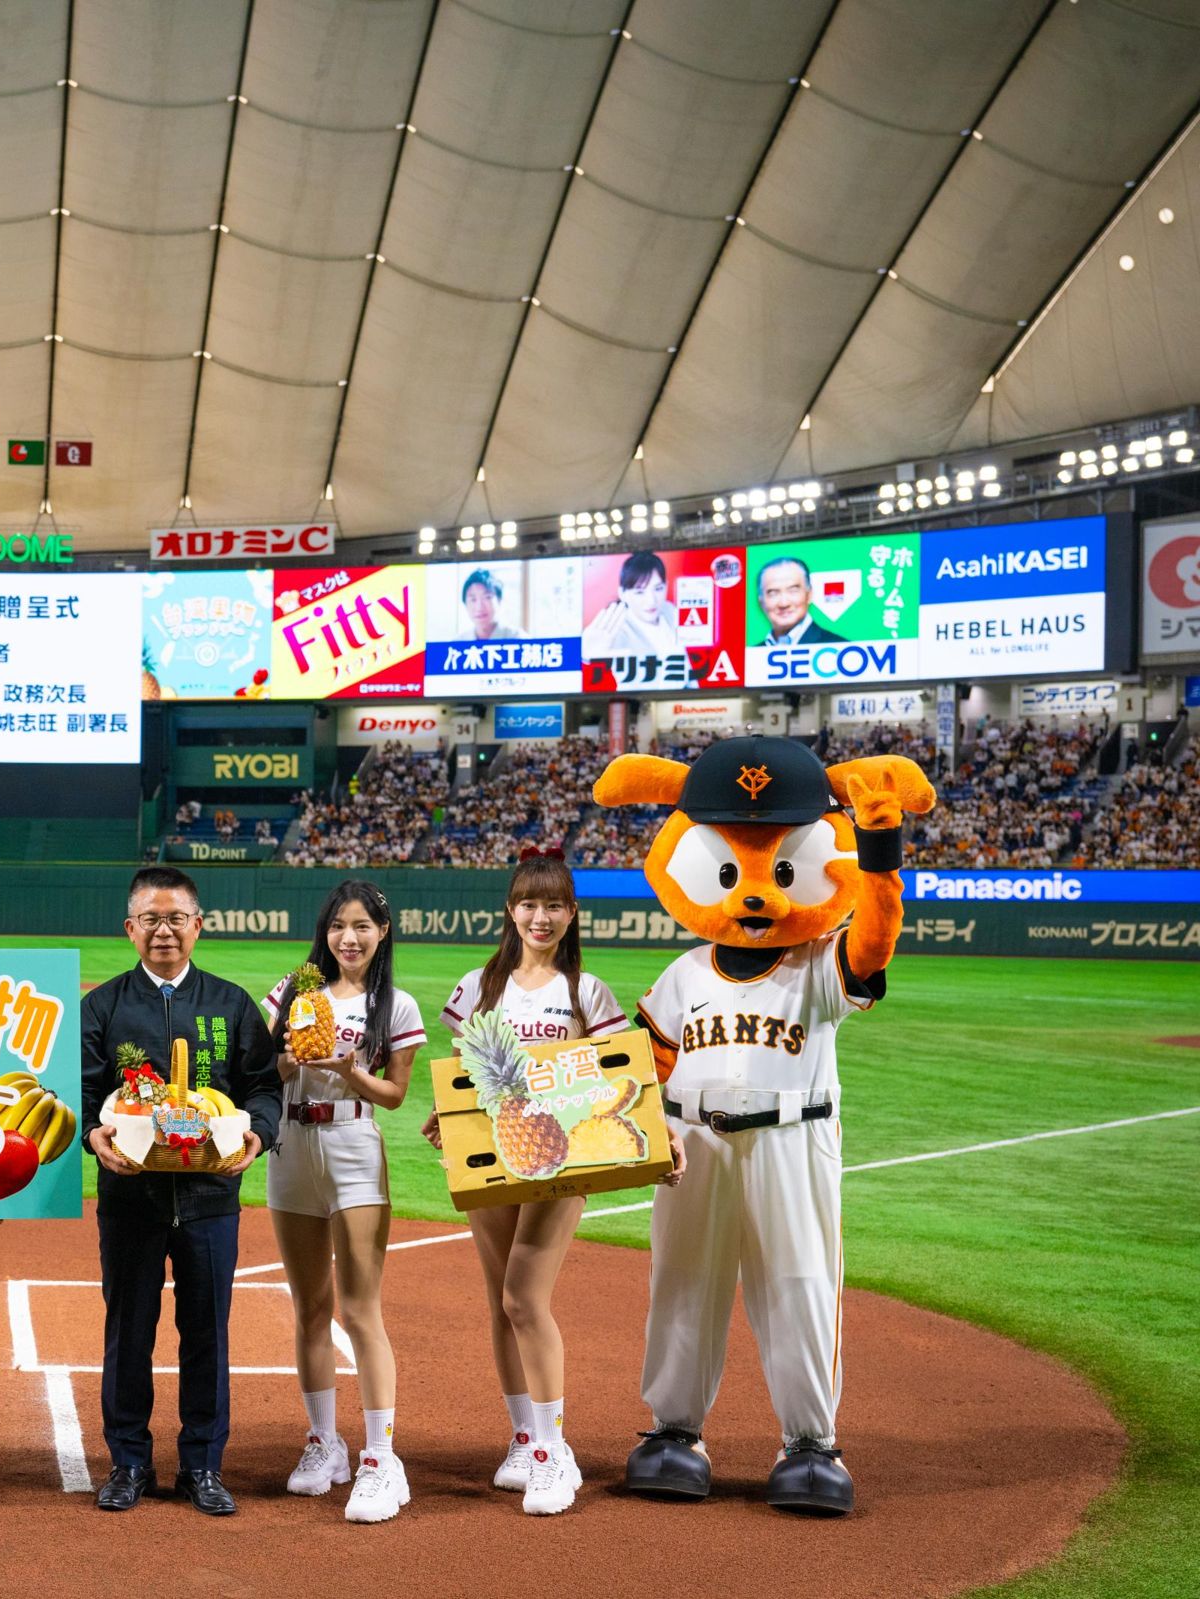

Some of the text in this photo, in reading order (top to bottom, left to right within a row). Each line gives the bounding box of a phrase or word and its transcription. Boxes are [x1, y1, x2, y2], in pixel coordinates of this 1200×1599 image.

[157, 526, 329, 557] オロナミンC
[300, 570, 352, 602] マスクは
[282, 584, 411, 675] Fitty
[936, 614, 1086, 641] HEBEL HAUS
[462, 642, 563, 671] 木下工務店
[589, 649, 739, 685] アリナミンA
[767, 645, 896, 680] SECOM
[3, 684, 87, 704] 政務次長
[1022, 685, 1116, 704] ニッテイライフ
[770, 713, 779, 726] 3
[838, 697, 916, 718] 昭和大学
[66, 713, 128, 733] 副署長
[358, 717, 436, 733] Denyo
[457, 723, 470, 737] 34
[213, 754, 298, 779] RYOBI
[211, 847, 247, 860] POINT
[915, 872, 1082, 900] Panasonic
[199, 909, 289, 933] anon
[579, 910, 698, 940] ビックカ
[1028, 926, 1087, 938] KONAMI
[683, 1013, 806, 1056] GIANTS
[526, 1050, 599, 1092] 台湾
